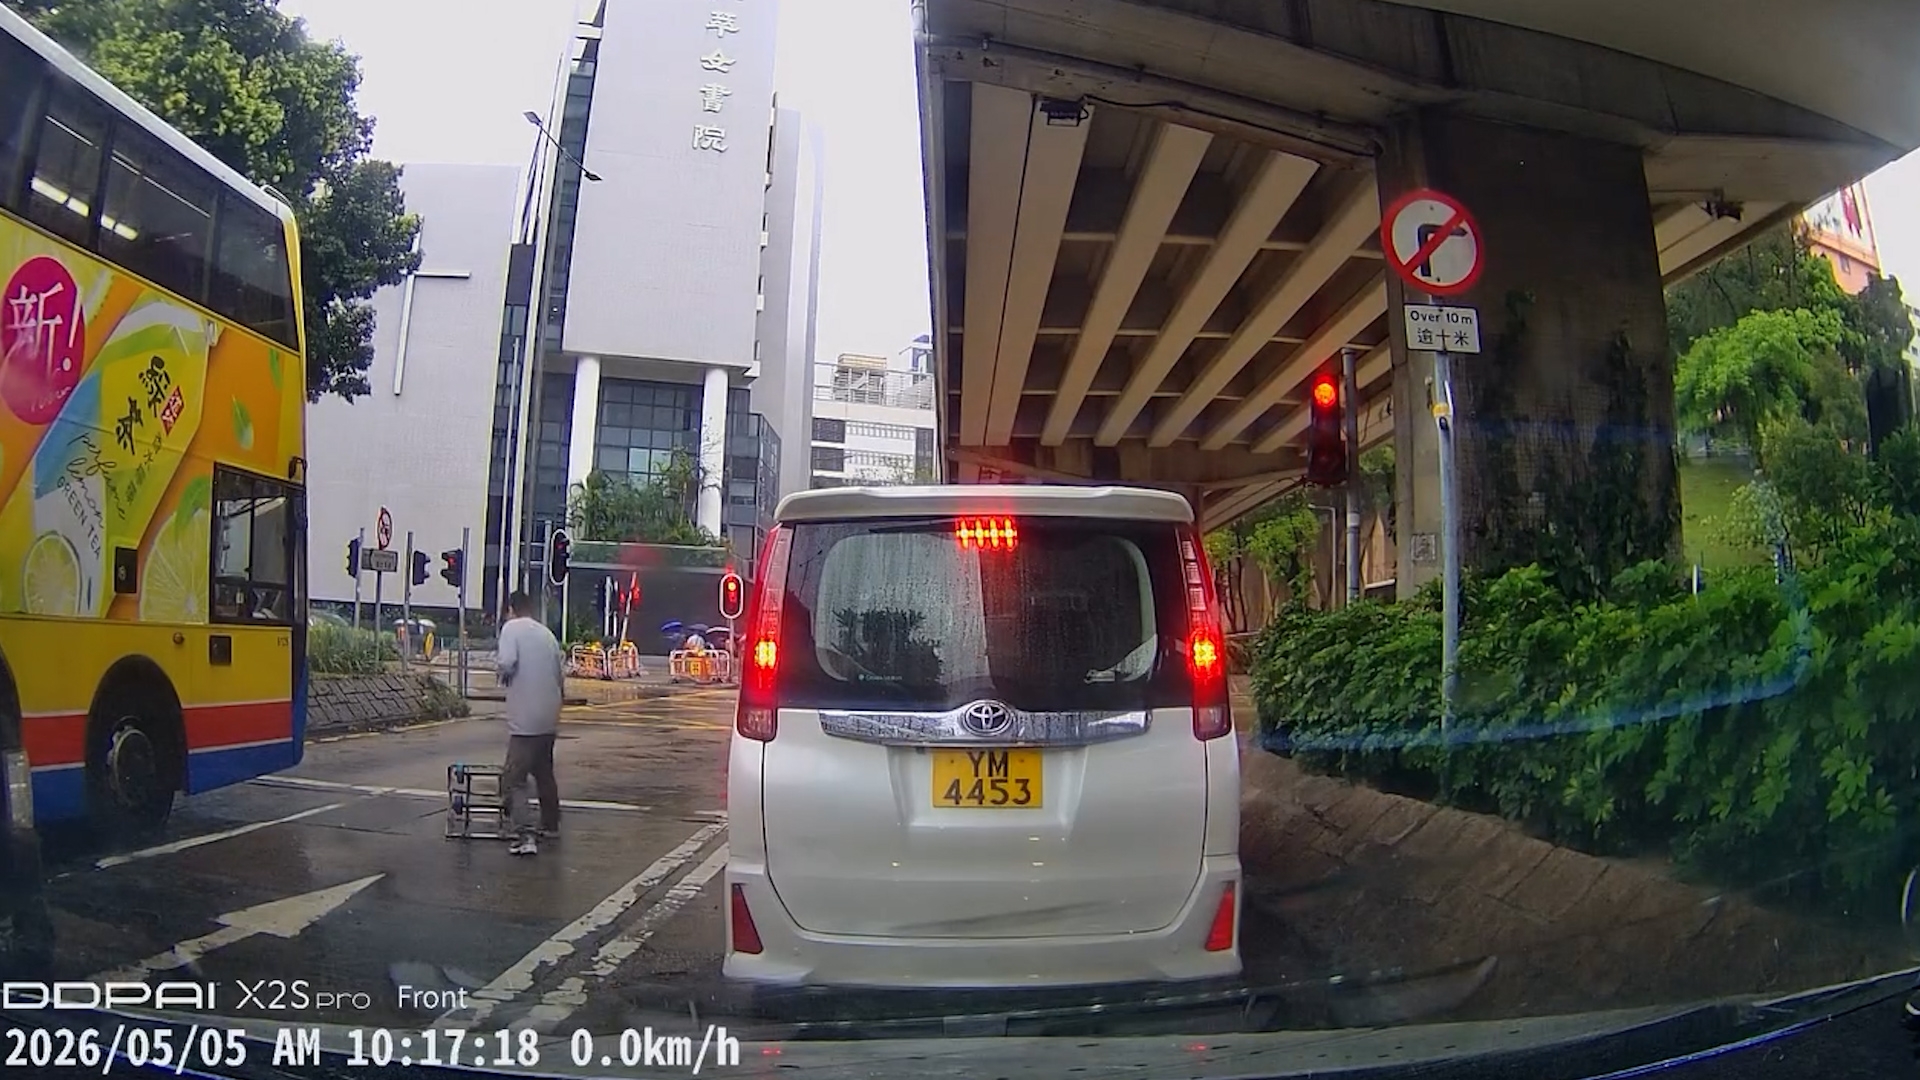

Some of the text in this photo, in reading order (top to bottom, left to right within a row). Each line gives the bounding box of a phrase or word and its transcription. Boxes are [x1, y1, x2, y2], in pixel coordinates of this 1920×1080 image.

[692, 0, 743, 153] 萃女書院
[1410, 310, 1440, 322] Over
[1417, 327, 1469, 346] 逾十米
[66, 457, 105, 529] lemon
[67, 431, 126, 520] perfume
[57, 476, 102, 561] GREEN TEA
[966, 751, 1008, 777] YM
[943, 778, 1031, 805] 4453
